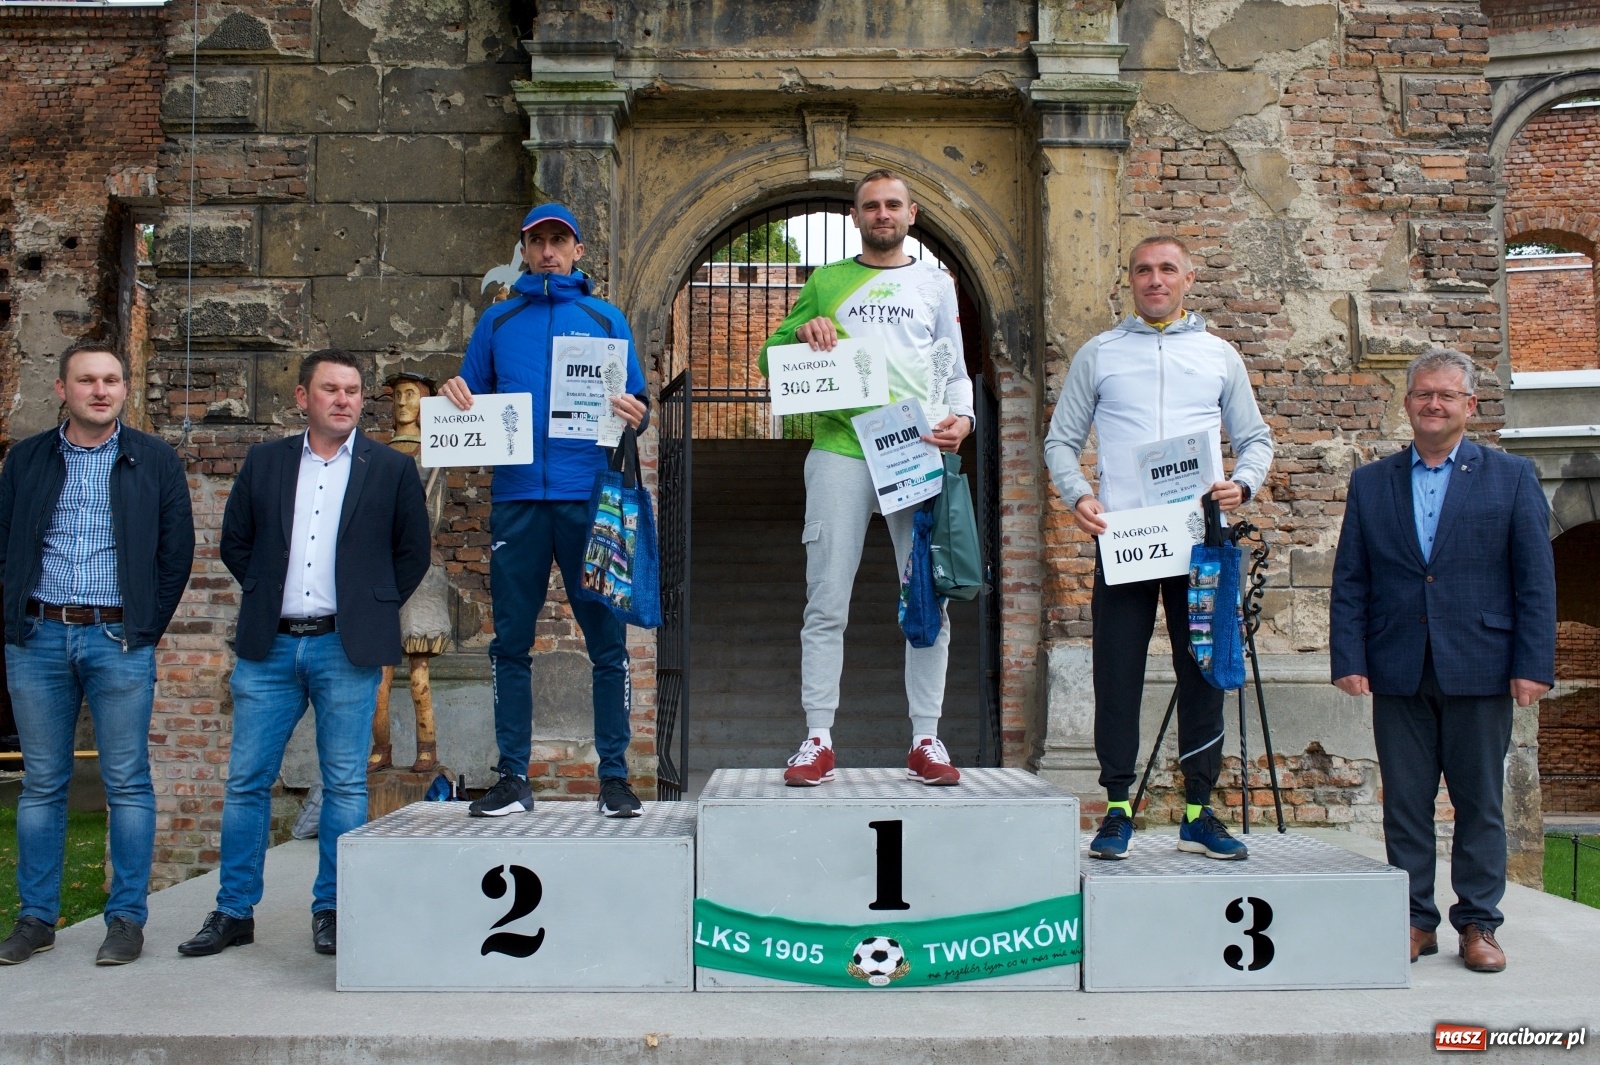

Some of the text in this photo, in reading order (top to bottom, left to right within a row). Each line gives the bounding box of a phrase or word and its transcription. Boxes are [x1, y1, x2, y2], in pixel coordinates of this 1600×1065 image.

[848, 304, 914, 319] AKTYWNI
[566, 364, 601, 378] DYPLO
[782, 359, 837, 373] NAGRODA
[780, 377, 840, 396] 300 ZŁ
[433, 414, 485, 424] NAGRODA
[429, 432, 487, 448] 200 ZŁ
[874, 425, 920, 451] DYPLOM
[1150, 457, 1199, 480] DYPLOM
[1112, 525, 1168, 540] NAGRODA
[1114, 542, 1174, 564] 100 ZŁ
[868, 819, 911, 911] 1
[481, 864, 546, 959] 2
[694, 921, 751, 954] LKS
[761, 937, 824, 965] 1905
[922, 917, 1079, 964] TWORKÓW
[1223, 896, 1275, 971] 3
